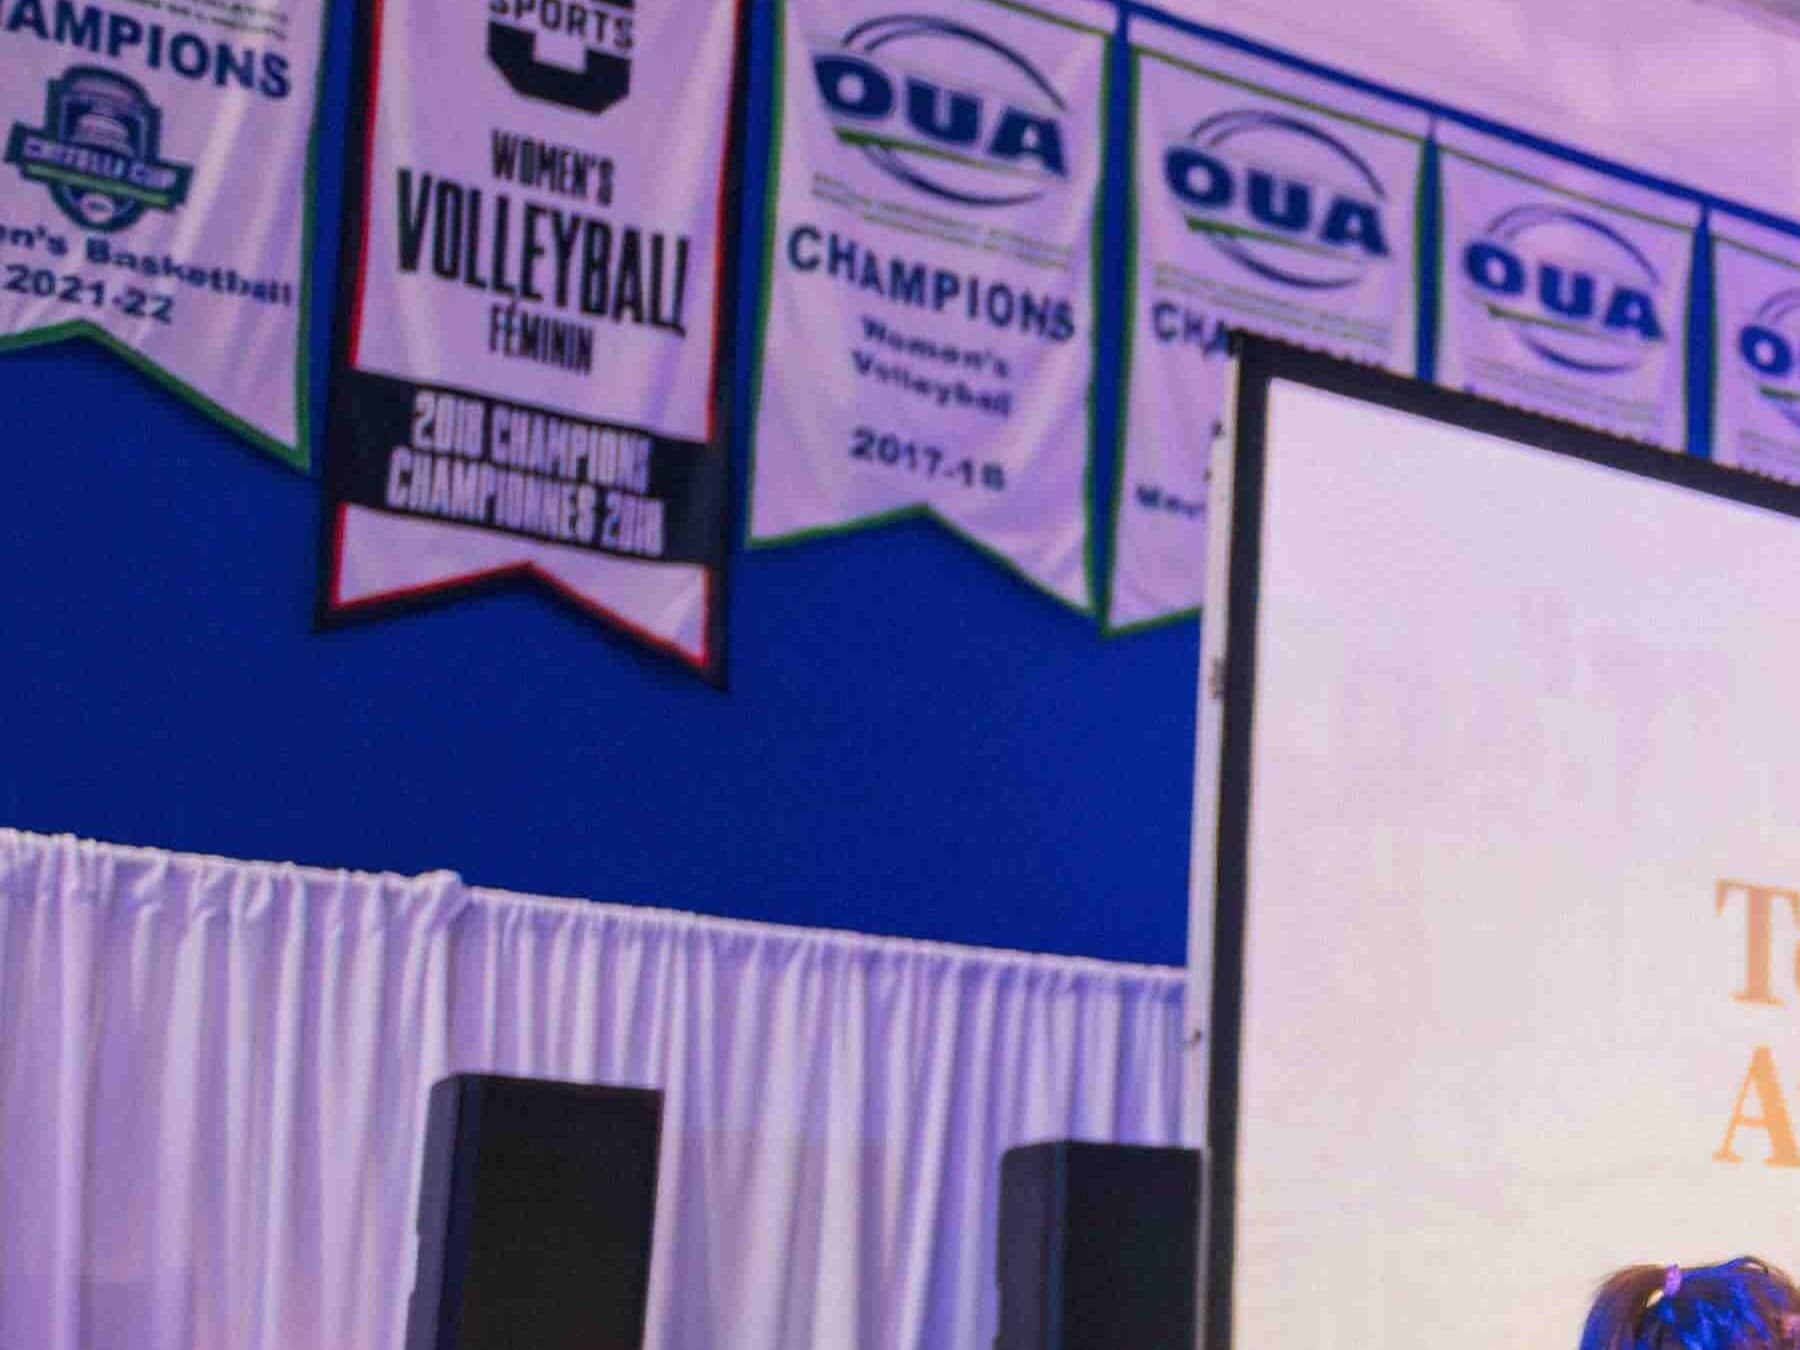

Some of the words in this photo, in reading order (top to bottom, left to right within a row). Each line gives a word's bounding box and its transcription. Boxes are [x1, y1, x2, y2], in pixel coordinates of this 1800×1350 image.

[812, 53, 1070, 180] OUA
[491, 129, 615, 206] WOMEN'S
[1163, 145, 1392, 257] OUA
[84, 235, 292, 306] Basketball
[396, 167, 691, 340] VOLLEYBALL
[786, 225, 1077, 343] CHAMPIONS
[1462, 239, 1665, 342] OUA
[4, 263, 174, 325] 2021-22
[851, 348, 1013, 420] Volleyball
[861, 314, 1010, 380] Women's
[850, 427, 1006, 492] 2017-18
